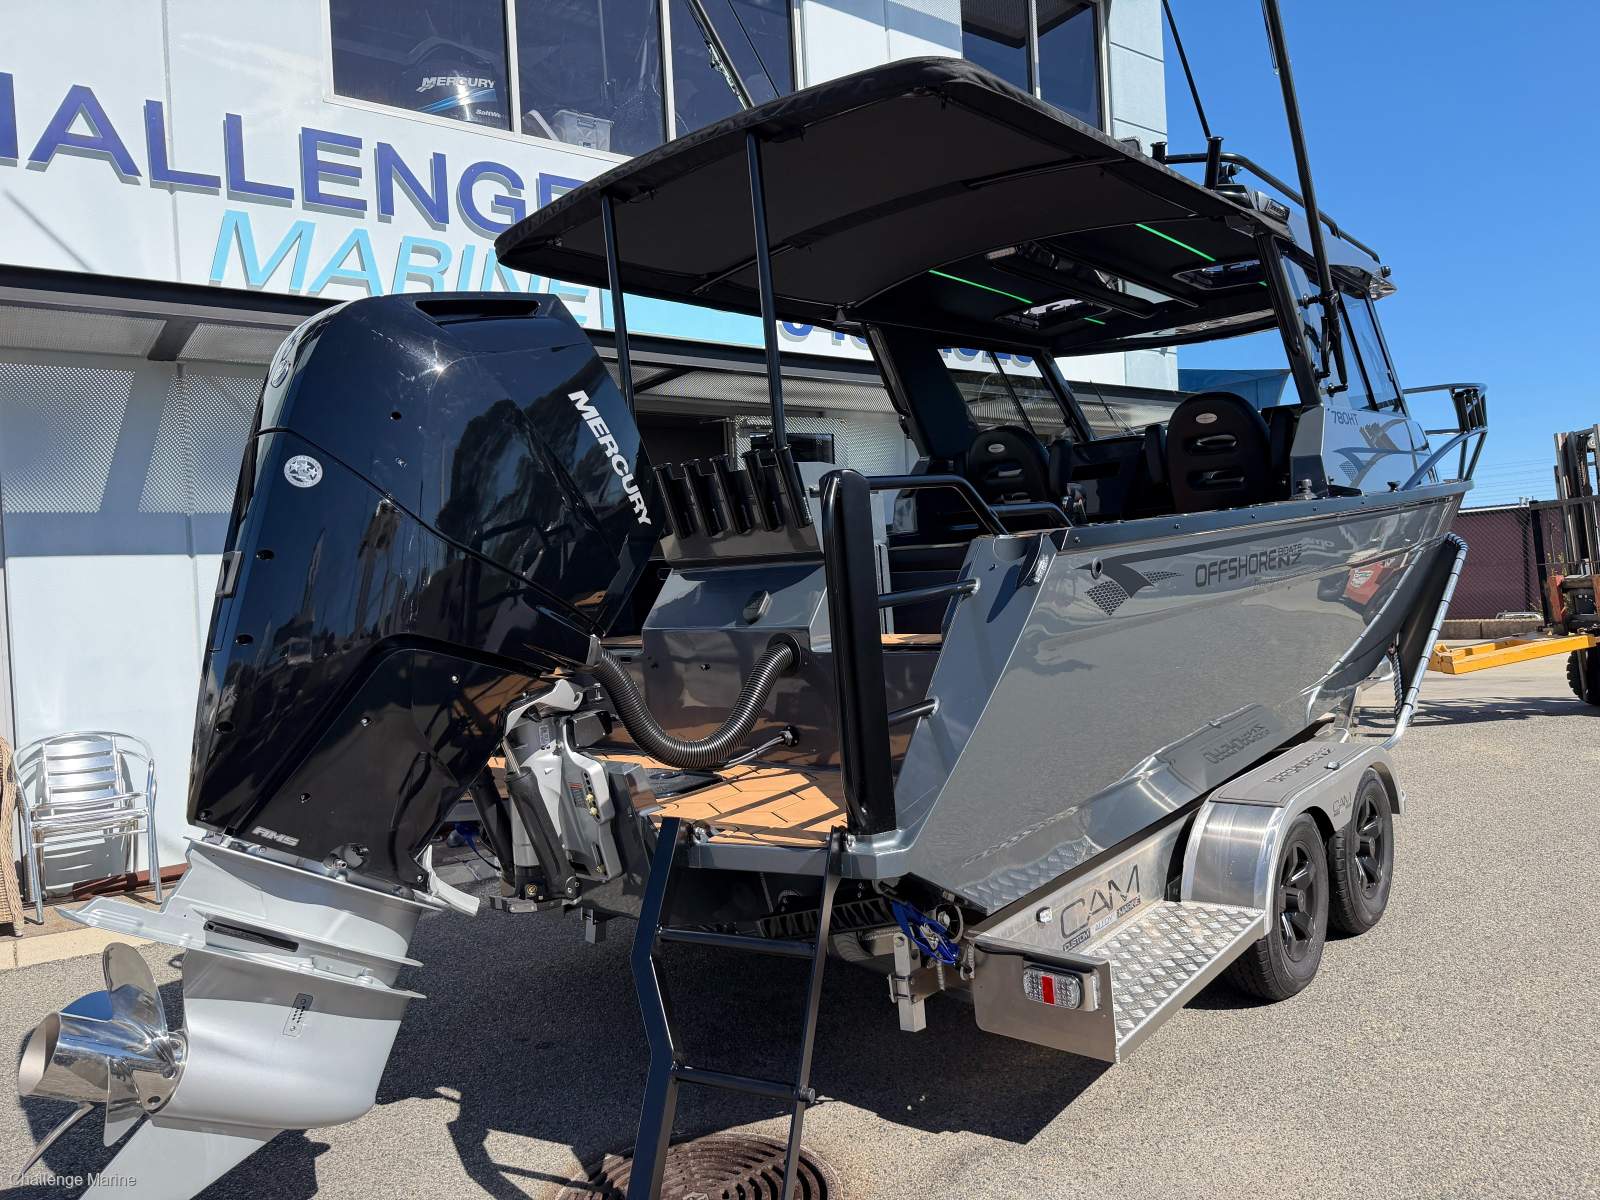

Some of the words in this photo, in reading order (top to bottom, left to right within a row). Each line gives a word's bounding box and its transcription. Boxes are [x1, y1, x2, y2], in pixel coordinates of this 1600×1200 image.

[420, 76, 495, 89] MERCURY
[0, 71, 587, 240] ALLENG
[1331, 410, 1359, 426] 780HT
[568, 390, 651, 525] MERCURY
[1195, 549, 1277, 588] OFFSHORE
[1061, 864, 1139, 939] CAM
[1063, 928, 1090, 951] CUSTOM
